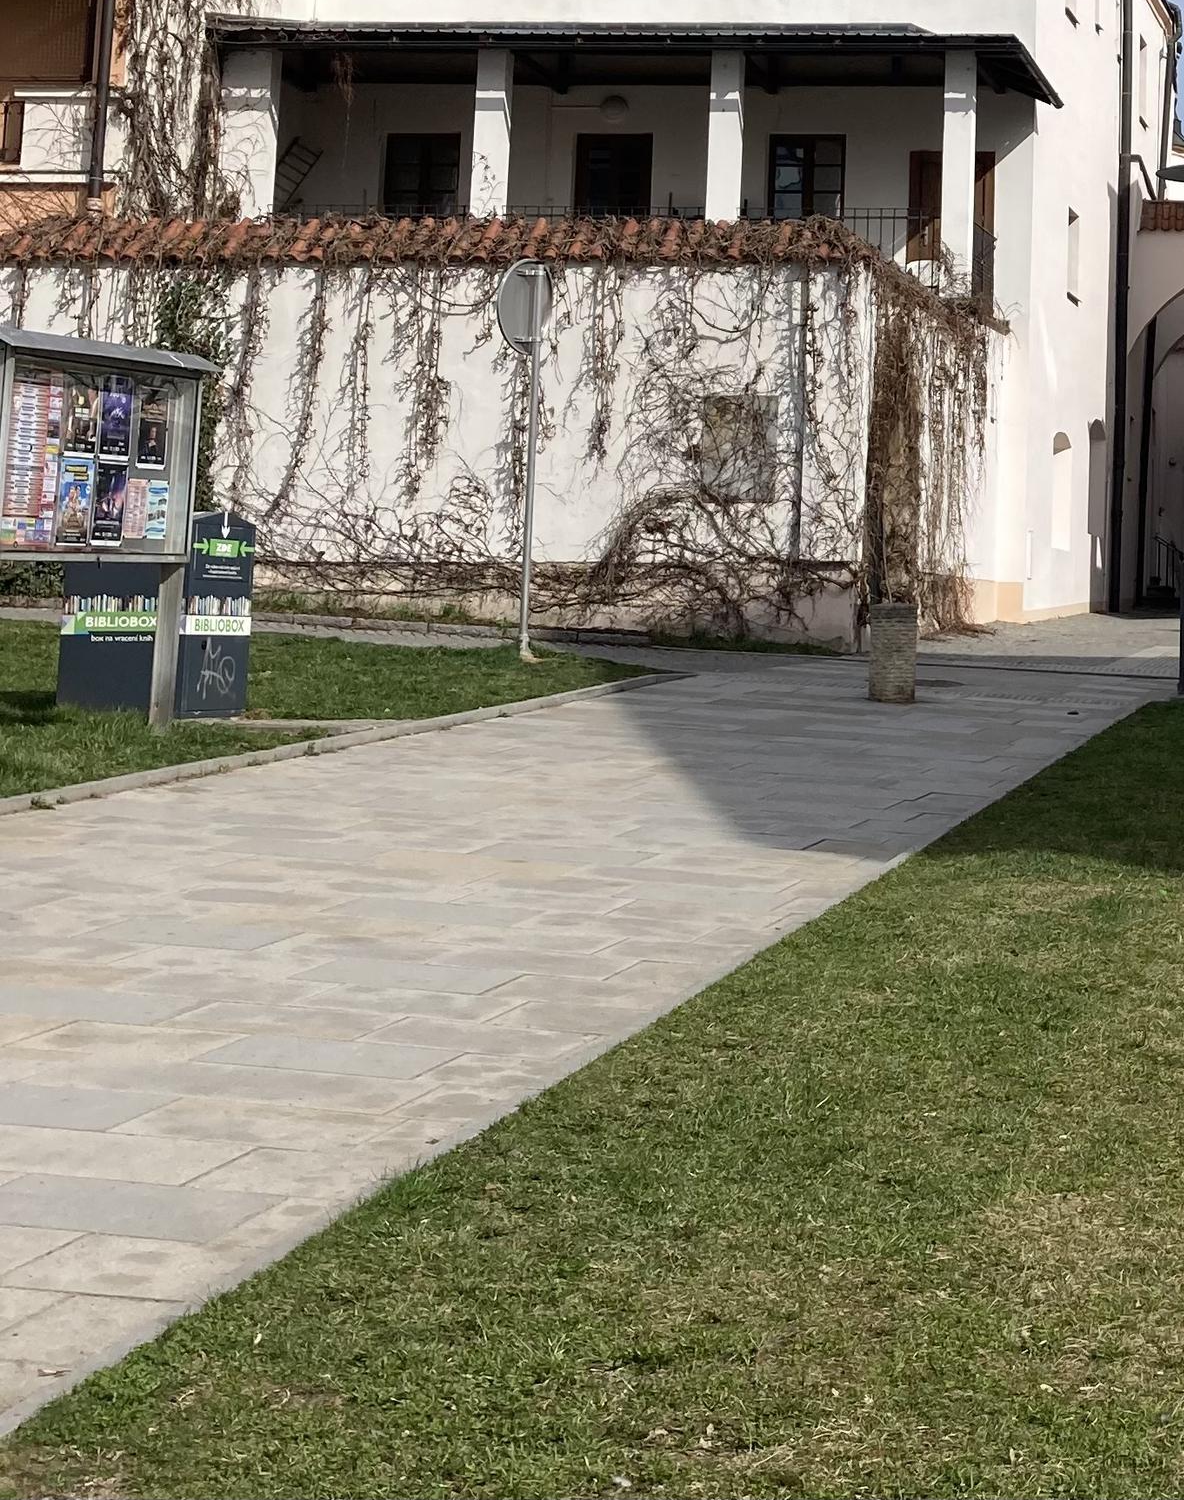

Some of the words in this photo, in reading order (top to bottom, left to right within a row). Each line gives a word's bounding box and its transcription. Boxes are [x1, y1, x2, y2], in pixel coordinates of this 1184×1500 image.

[215, 542, 233, 553] ZDE
[85, 615, 158, 628] BIBLIOBOX
[194, 618, 245, 633] BIBLIOBOX
[90, 634, 104, 642] box
[114, 634, 139, 642] vracení
[139, 634, 154, 642] knih
